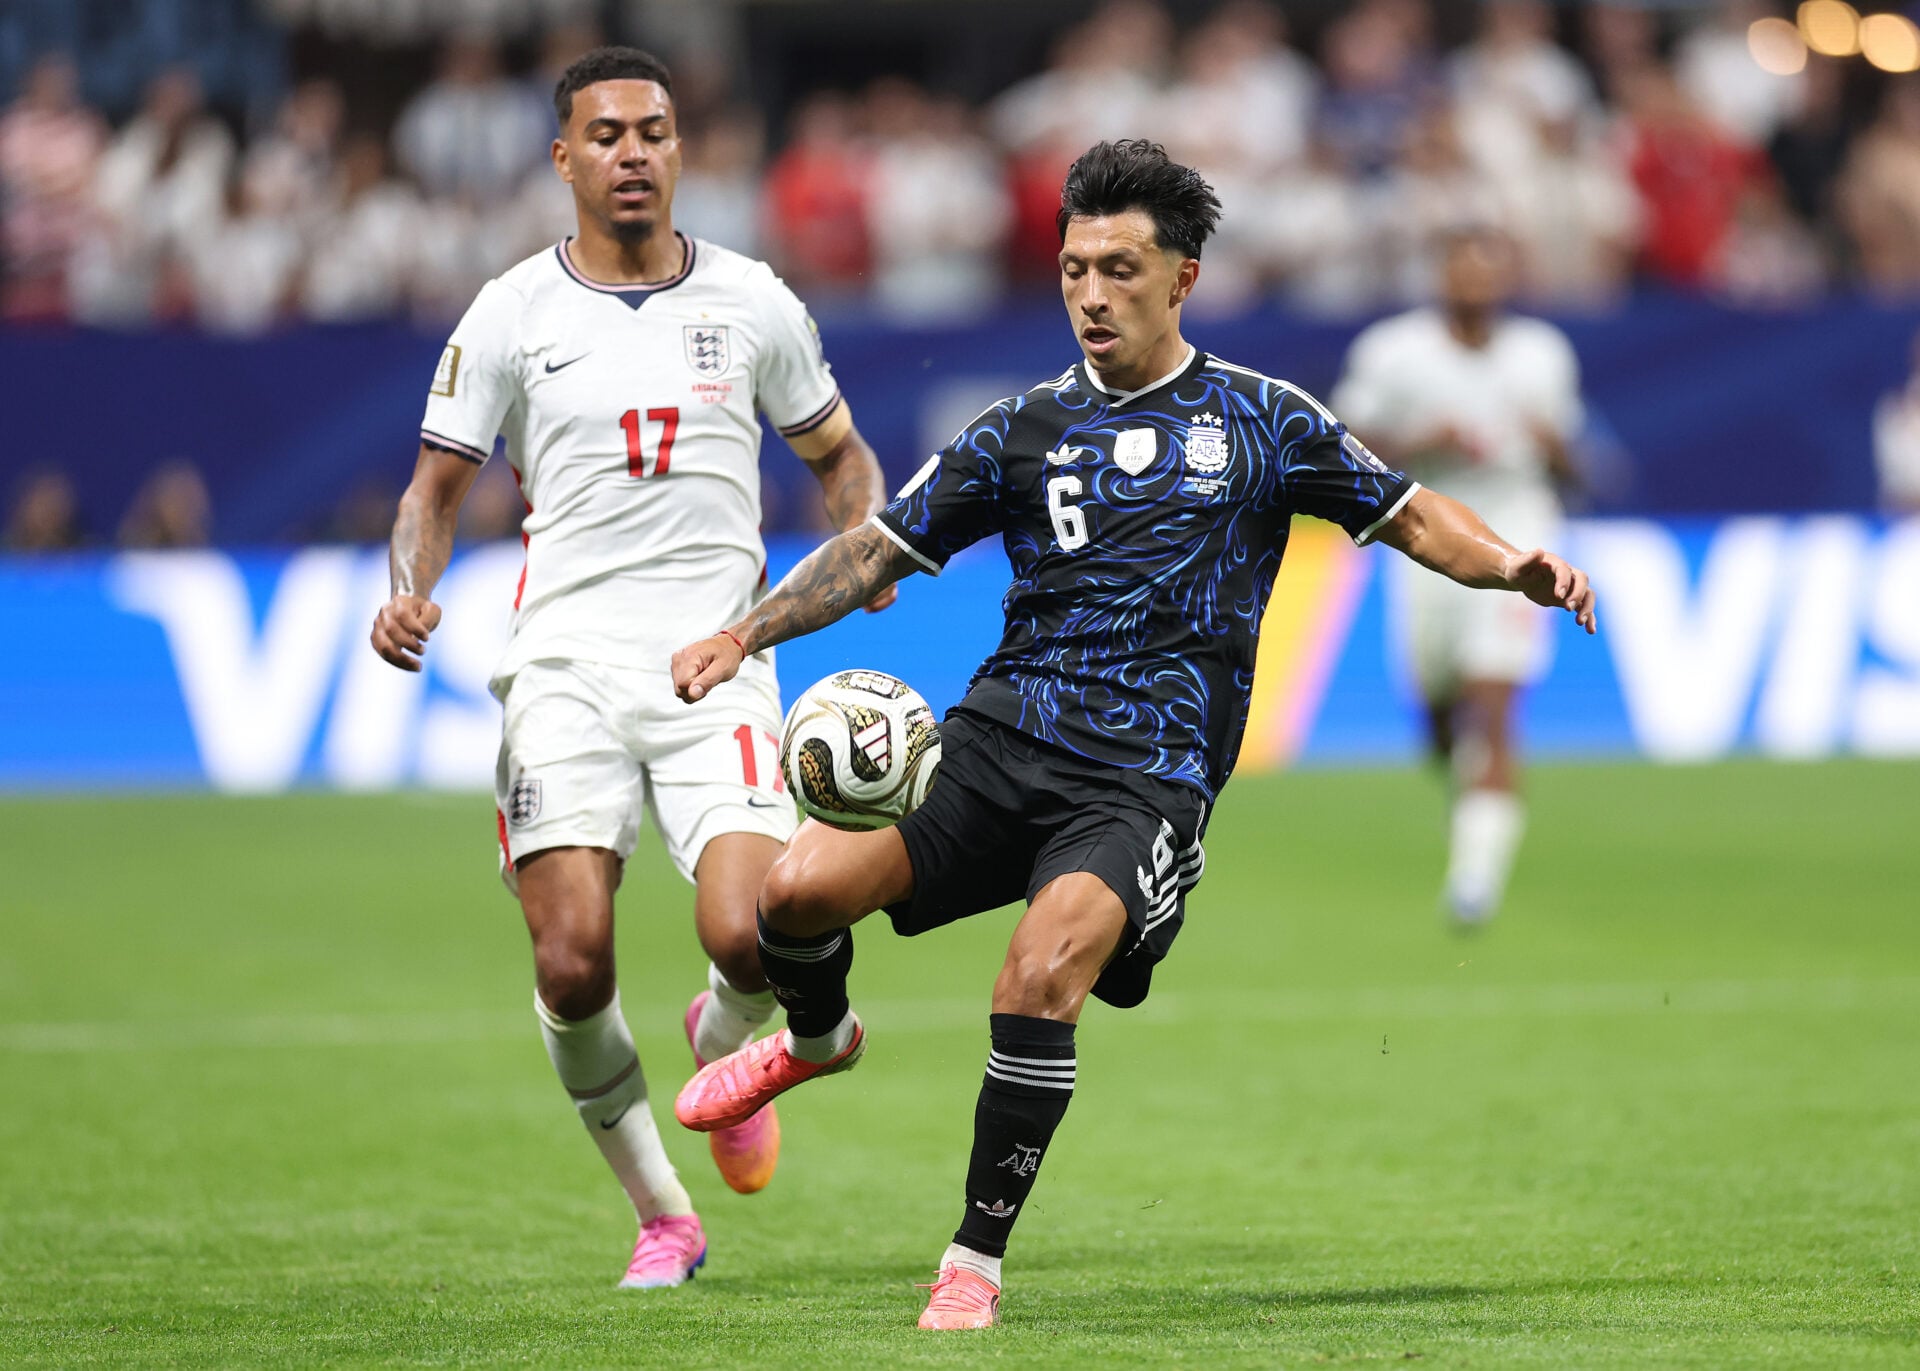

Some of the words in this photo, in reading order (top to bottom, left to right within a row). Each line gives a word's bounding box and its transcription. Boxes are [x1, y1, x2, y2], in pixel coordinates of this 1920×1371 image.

[619, 407, 680, 478] 17
[1195, 438, 1218, 459] AFA
[1046, 475, 1089, 552] 6
[996, 1142, 1041, 1177] AFA
